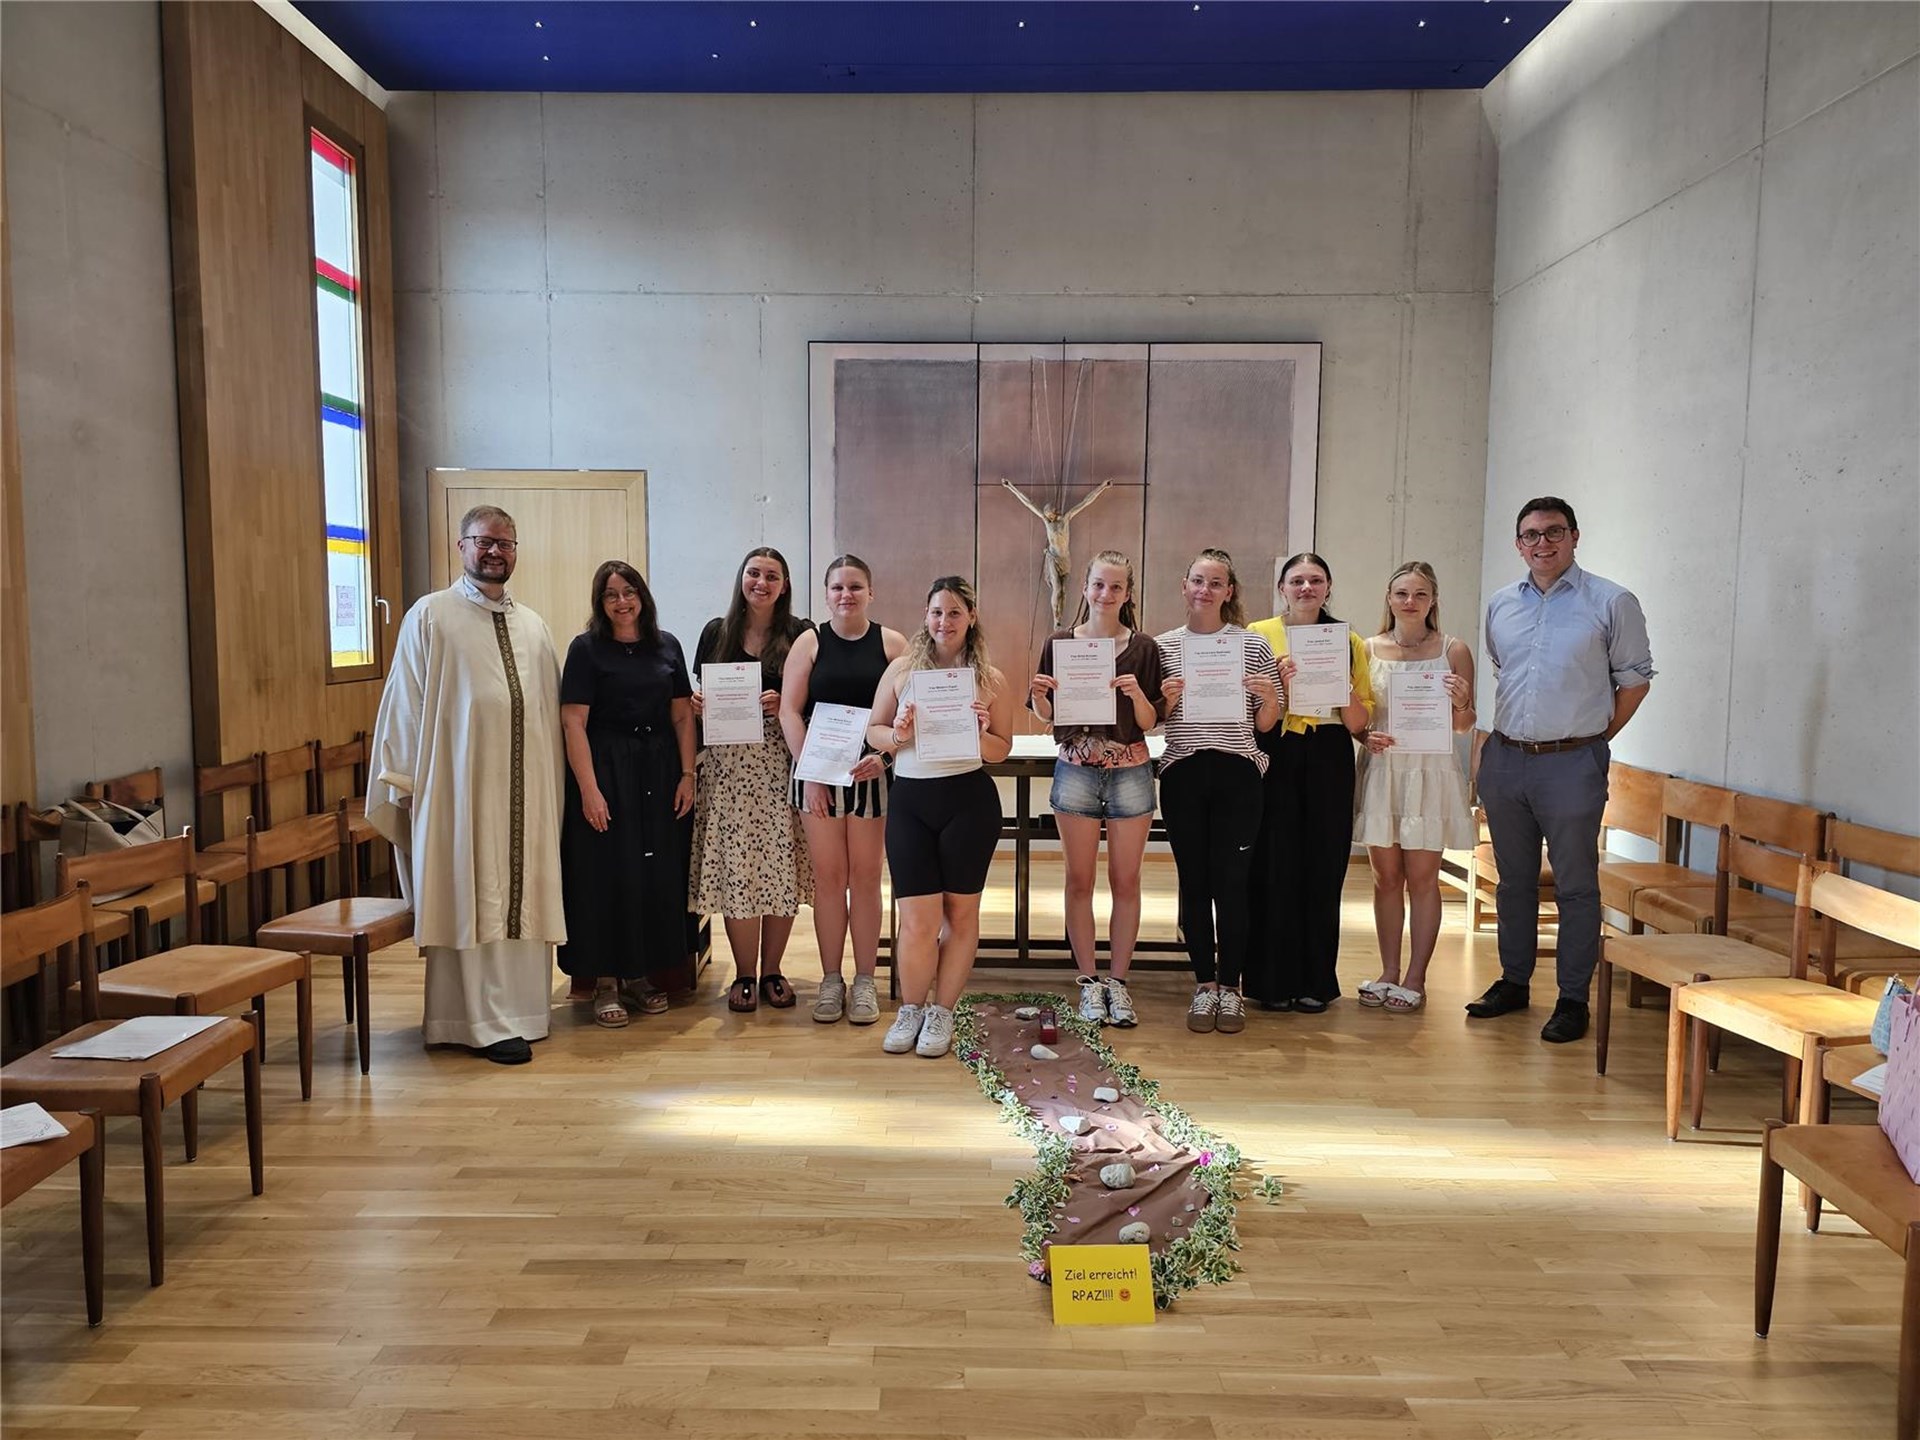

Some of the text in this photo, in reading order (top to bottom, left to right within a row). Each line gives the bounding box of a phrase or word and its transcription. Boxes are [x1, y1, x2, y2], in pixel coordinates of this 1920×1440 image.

[1065, 1268, 1137, 1281] Ziel erreicht!
[1072, 1289, 1114, 1302] RPAZ!!!!
